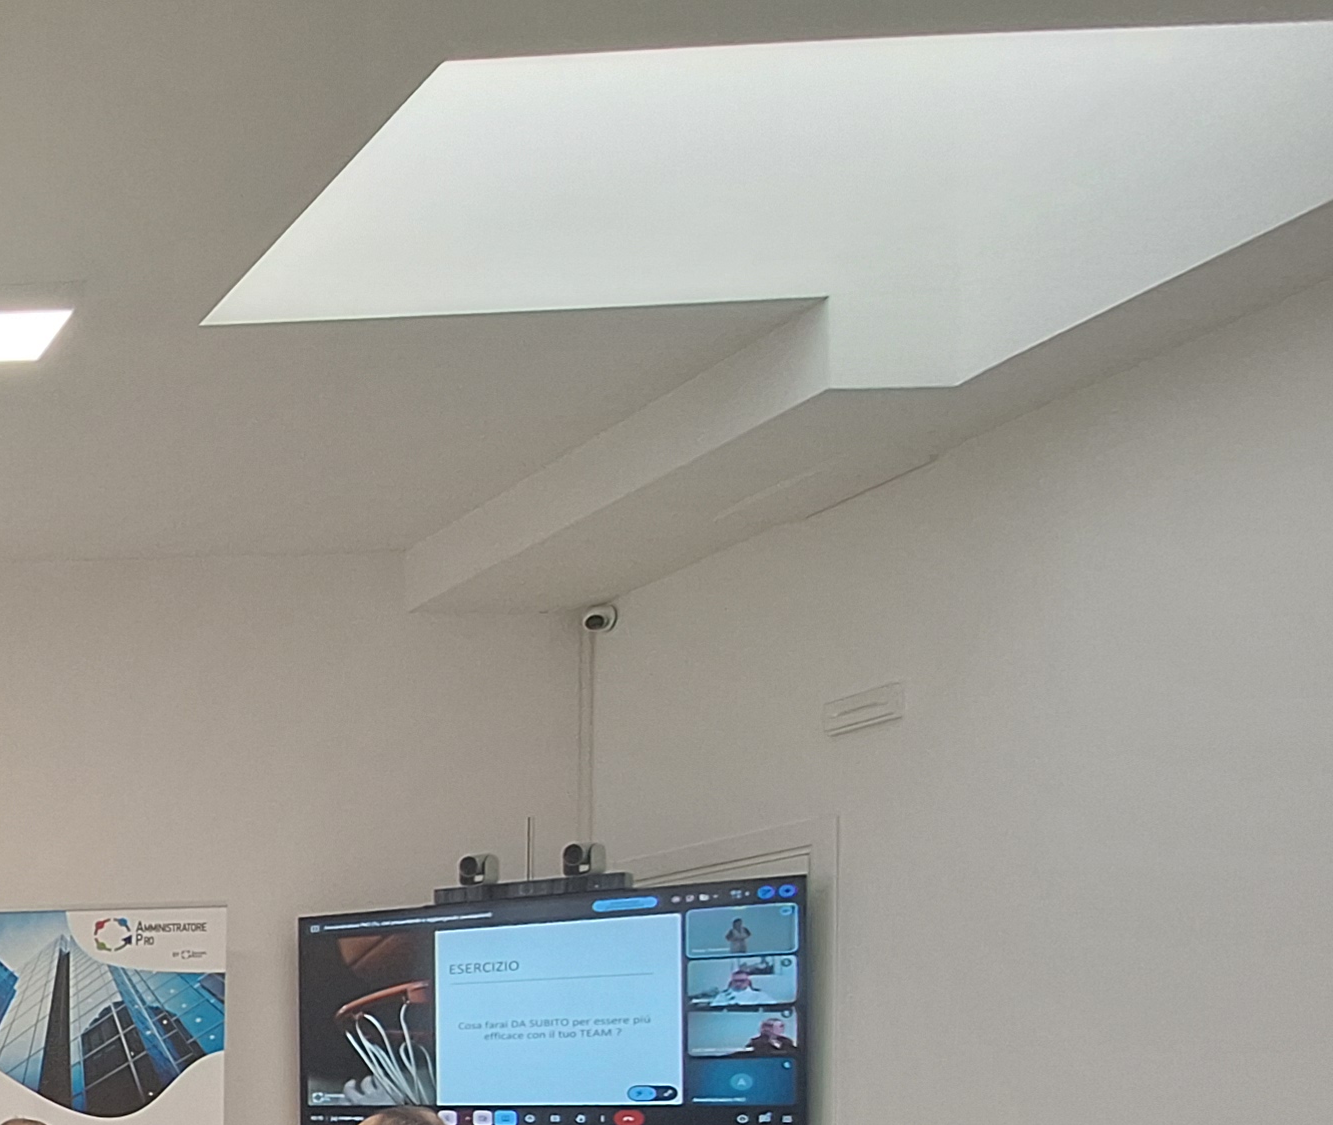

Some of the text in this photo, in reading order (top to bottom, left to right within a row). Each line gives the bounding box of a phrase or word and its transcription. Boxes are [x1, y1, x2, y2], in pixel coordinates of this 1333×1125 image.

[136, 920, 207, 932] AMMINISTRATORE
[136, 933, 155, 946] PRO
[449, 960, 520, 975] ESERCIZIO
[458, 1022, 482, 1030] Cosa
[485, 1021, 508, 1029] farai
[511, 1020, 526, 1028] DA
[529, 1018, 570, 1028] SUBITO
[573, 1018, 591, 1028] per
[593, 1018, 629, 1026] essere
[484, 1027, 623, 1040] efficace con il tuo TEAM ?
